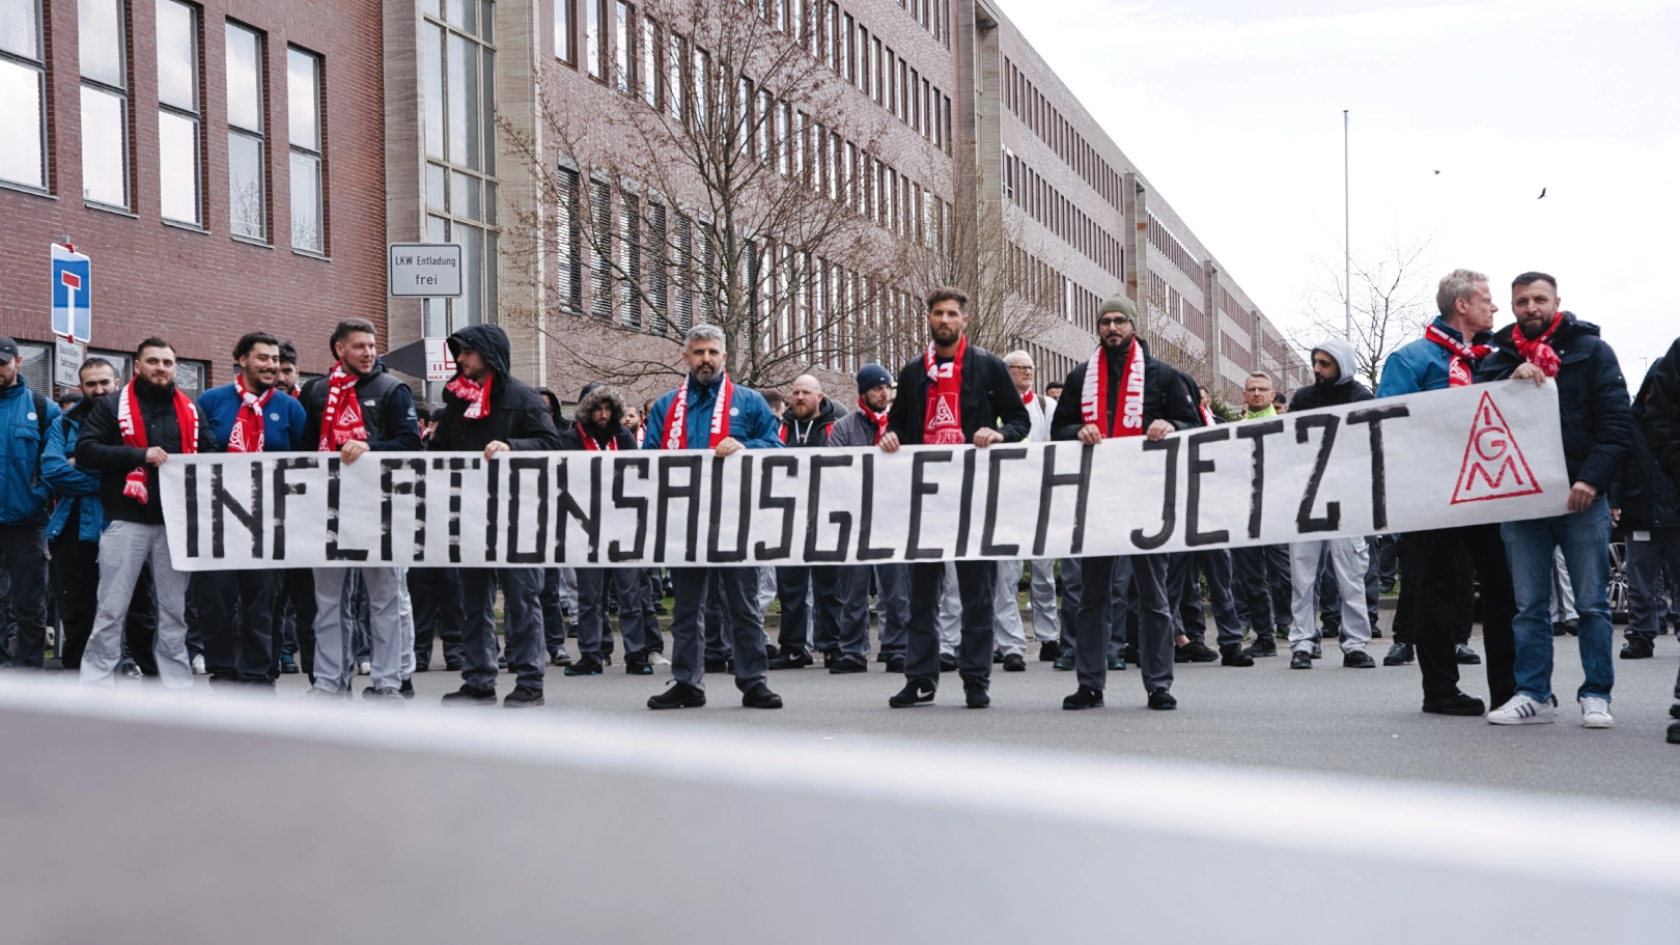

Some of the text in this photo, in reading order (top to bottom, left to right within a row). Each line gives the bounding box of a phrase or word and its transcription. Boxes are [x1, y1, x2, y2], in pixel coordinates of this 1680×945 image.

[395, 255, 456, 268] LKW Entladung
[415, 274, 438, 285] frei
[186, 444, 1093, 563] INFLATIONSAUSGLEICH
[1131, 404, 1409, 549] JETZT
